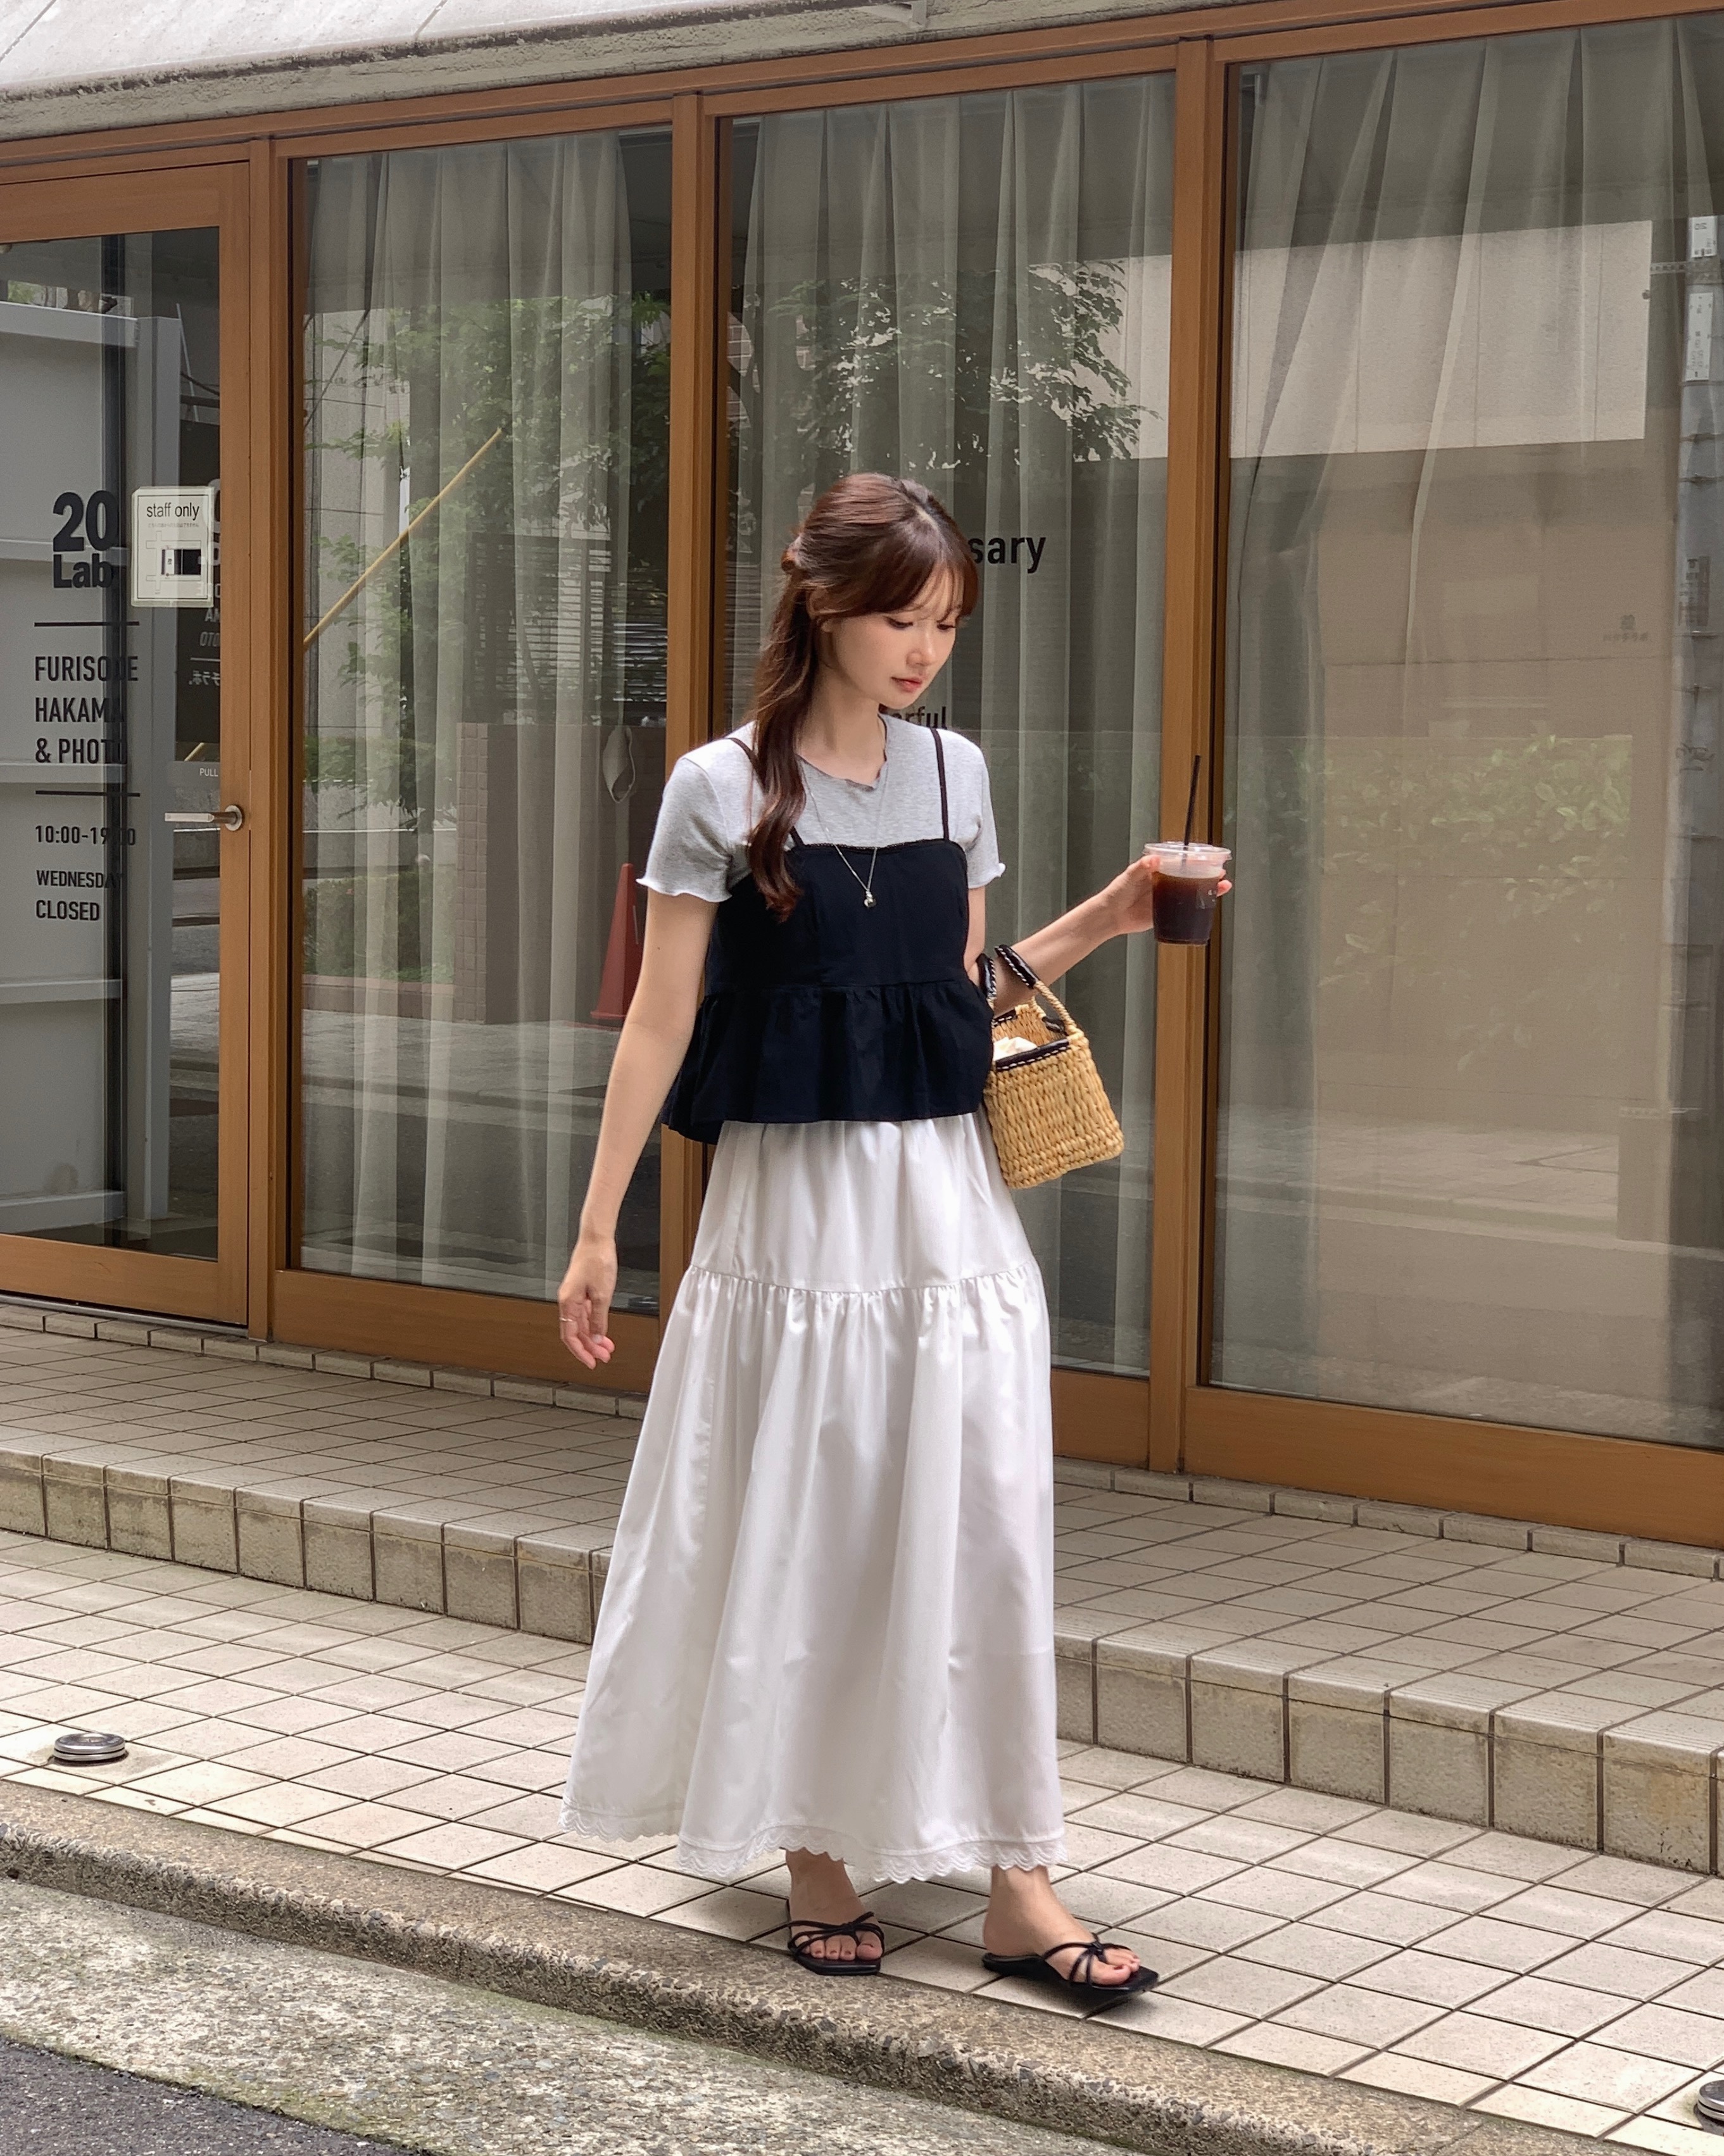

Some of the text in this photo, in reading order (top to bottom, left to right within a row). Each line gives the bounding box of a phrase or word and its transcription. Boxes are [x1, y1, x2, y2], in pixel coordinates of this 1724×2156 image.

[53, 490, 119, 552] 20
[146, 502, 199, 520] staff only
[967, 537, 1046, 574] sary
[53, 553, 113, 588] Lab
[35, 738, 51, 764] &
[199, 768, 218, 777] PULL
[35, 825, 136, 846] 10:00-190
[35, 900, 100, 921] CLOSED
